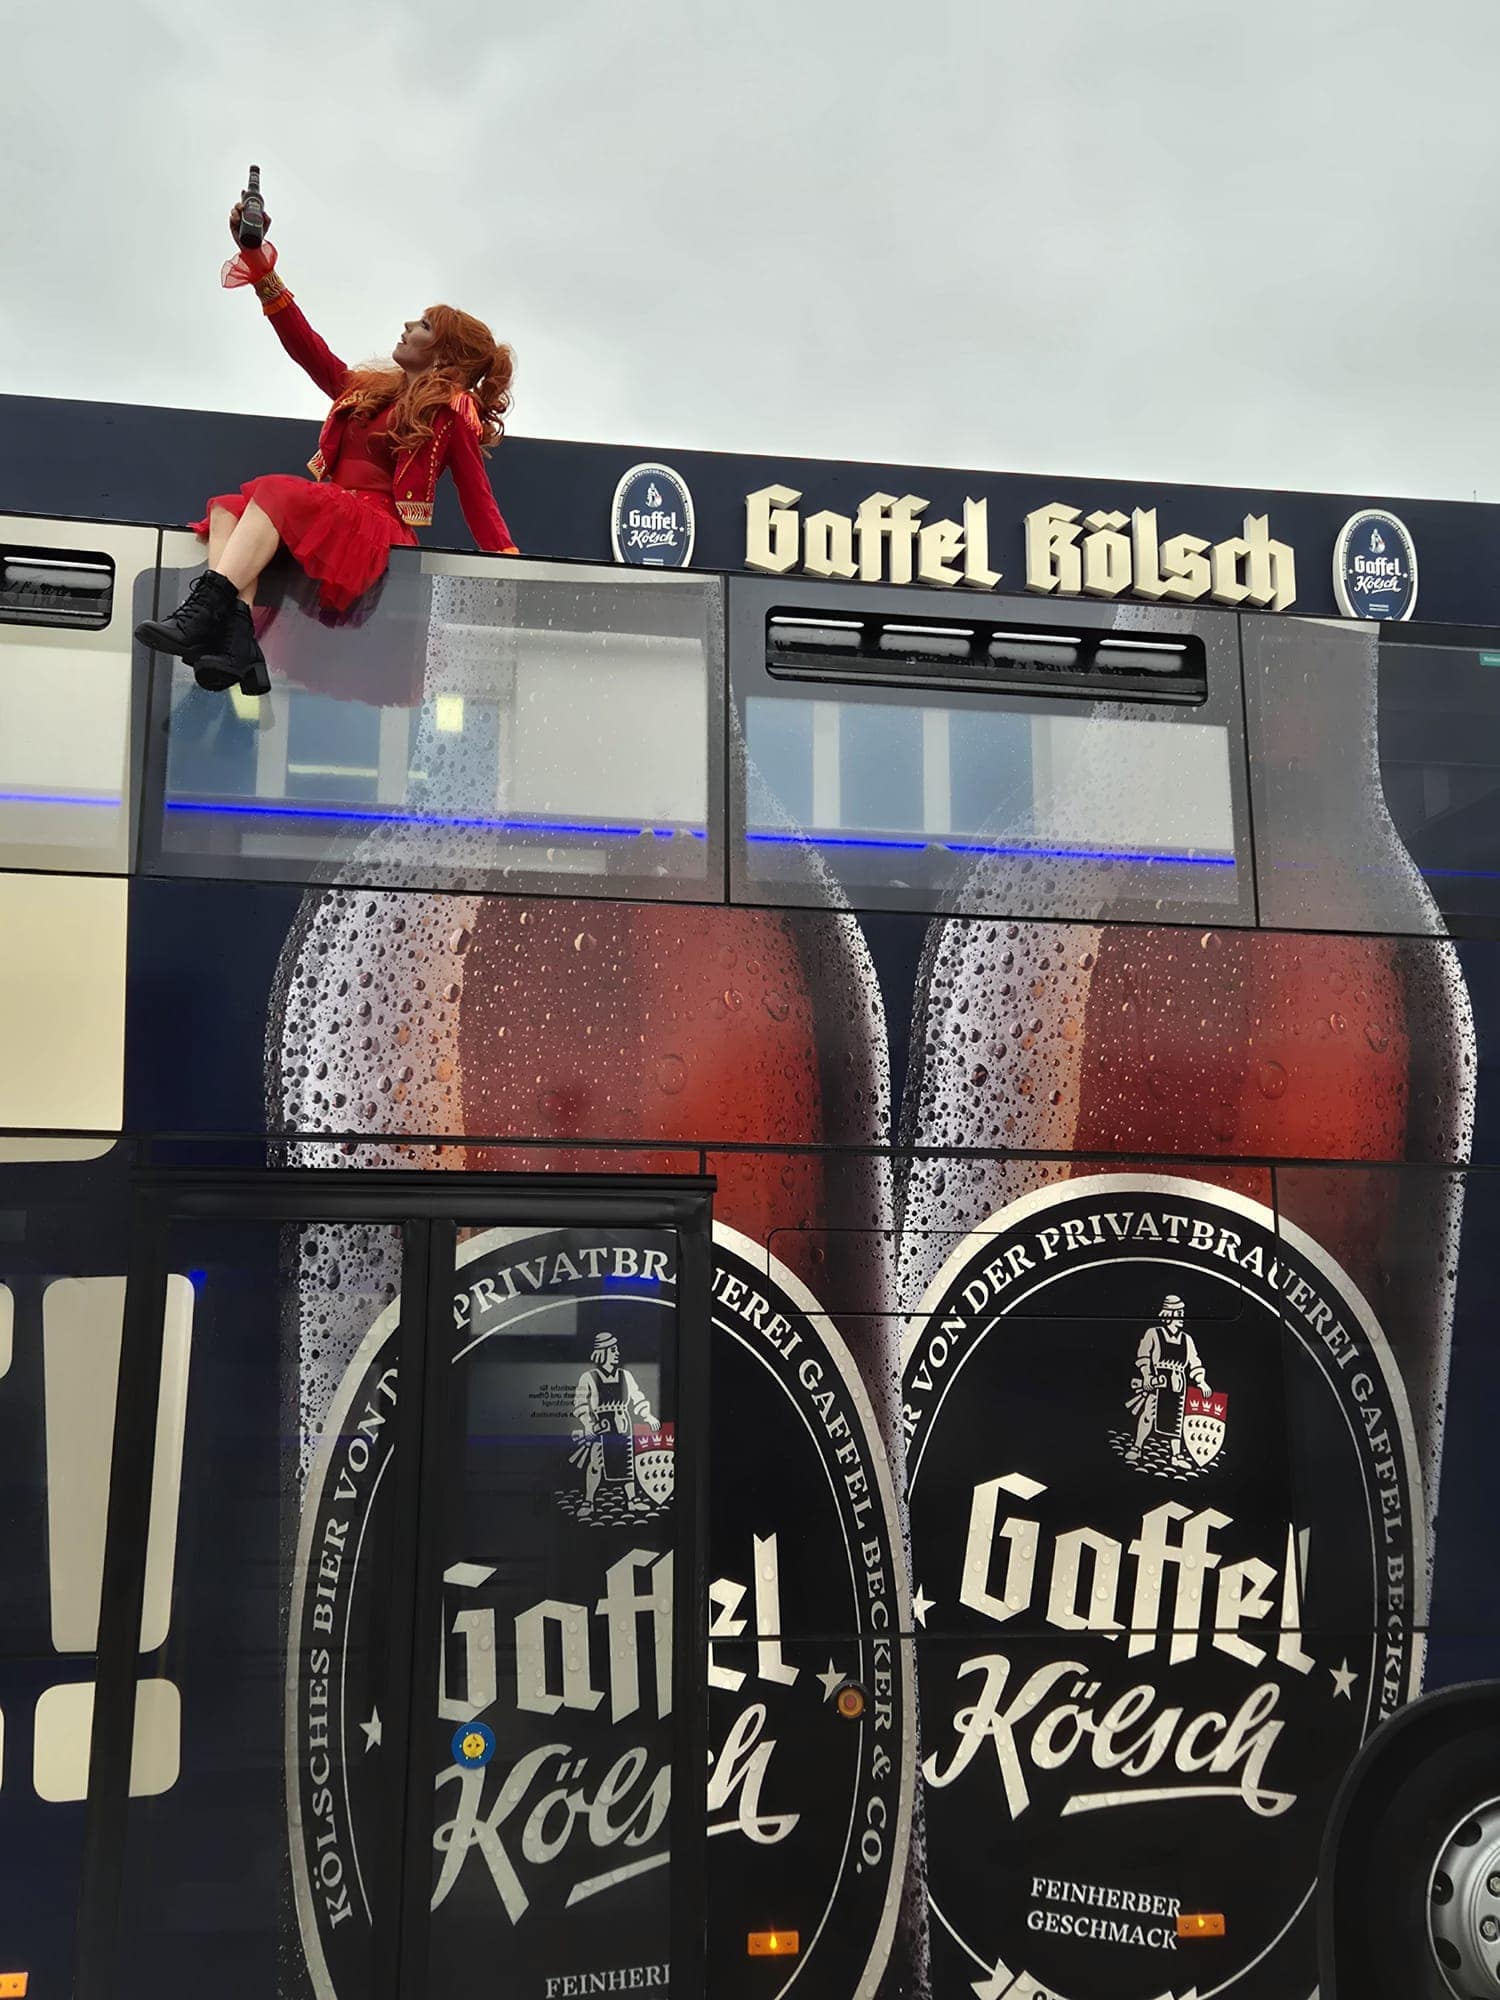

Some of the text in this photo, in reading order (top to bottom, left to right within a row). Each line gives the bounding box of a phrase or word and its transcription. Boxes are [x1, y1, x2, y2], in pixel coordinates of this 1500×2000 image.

[627, 530, 678, 549] Kölsch
[629, 509, 679, 531] Gaffel
[744, 484, 1003, 592] Gaffel
[1024, 502, 1297, 611] Kölsch
[1354, 555, 1402, 577] Gaffel
[1353, 576, 1402, 594] Kölsch
[911, 1305, 967, 1391] VON
[961, 1244, 1037, 1315] DER
[1035, 1211, 1360, 1370] PRIVATBRAUEREI
[1351, 1371, 1403, 1544] GAFFEL
[334, 1401, 387, 1505] VON
[797, 1358, 873, 1530] GAFFEL
[313, 1517, 349, 1634] BIER
[960, 1472, 1316, 1675] Gaffel
[861, 1536, 892, 1731] BECKER
[309, 1648, 353, 1930] KÖLSCHES
[871, 1744, 891, 1780] &
[921, 1653, 1298, 1821] Kölsch
[430, 1703, 801, 1926] Kölsh
[856, 1796, 887, 1874] CO.
[1026, 1909, 1179, 1951] GESCHMACK
[1030, 1876, 1182, 1919] FEINHERBER
